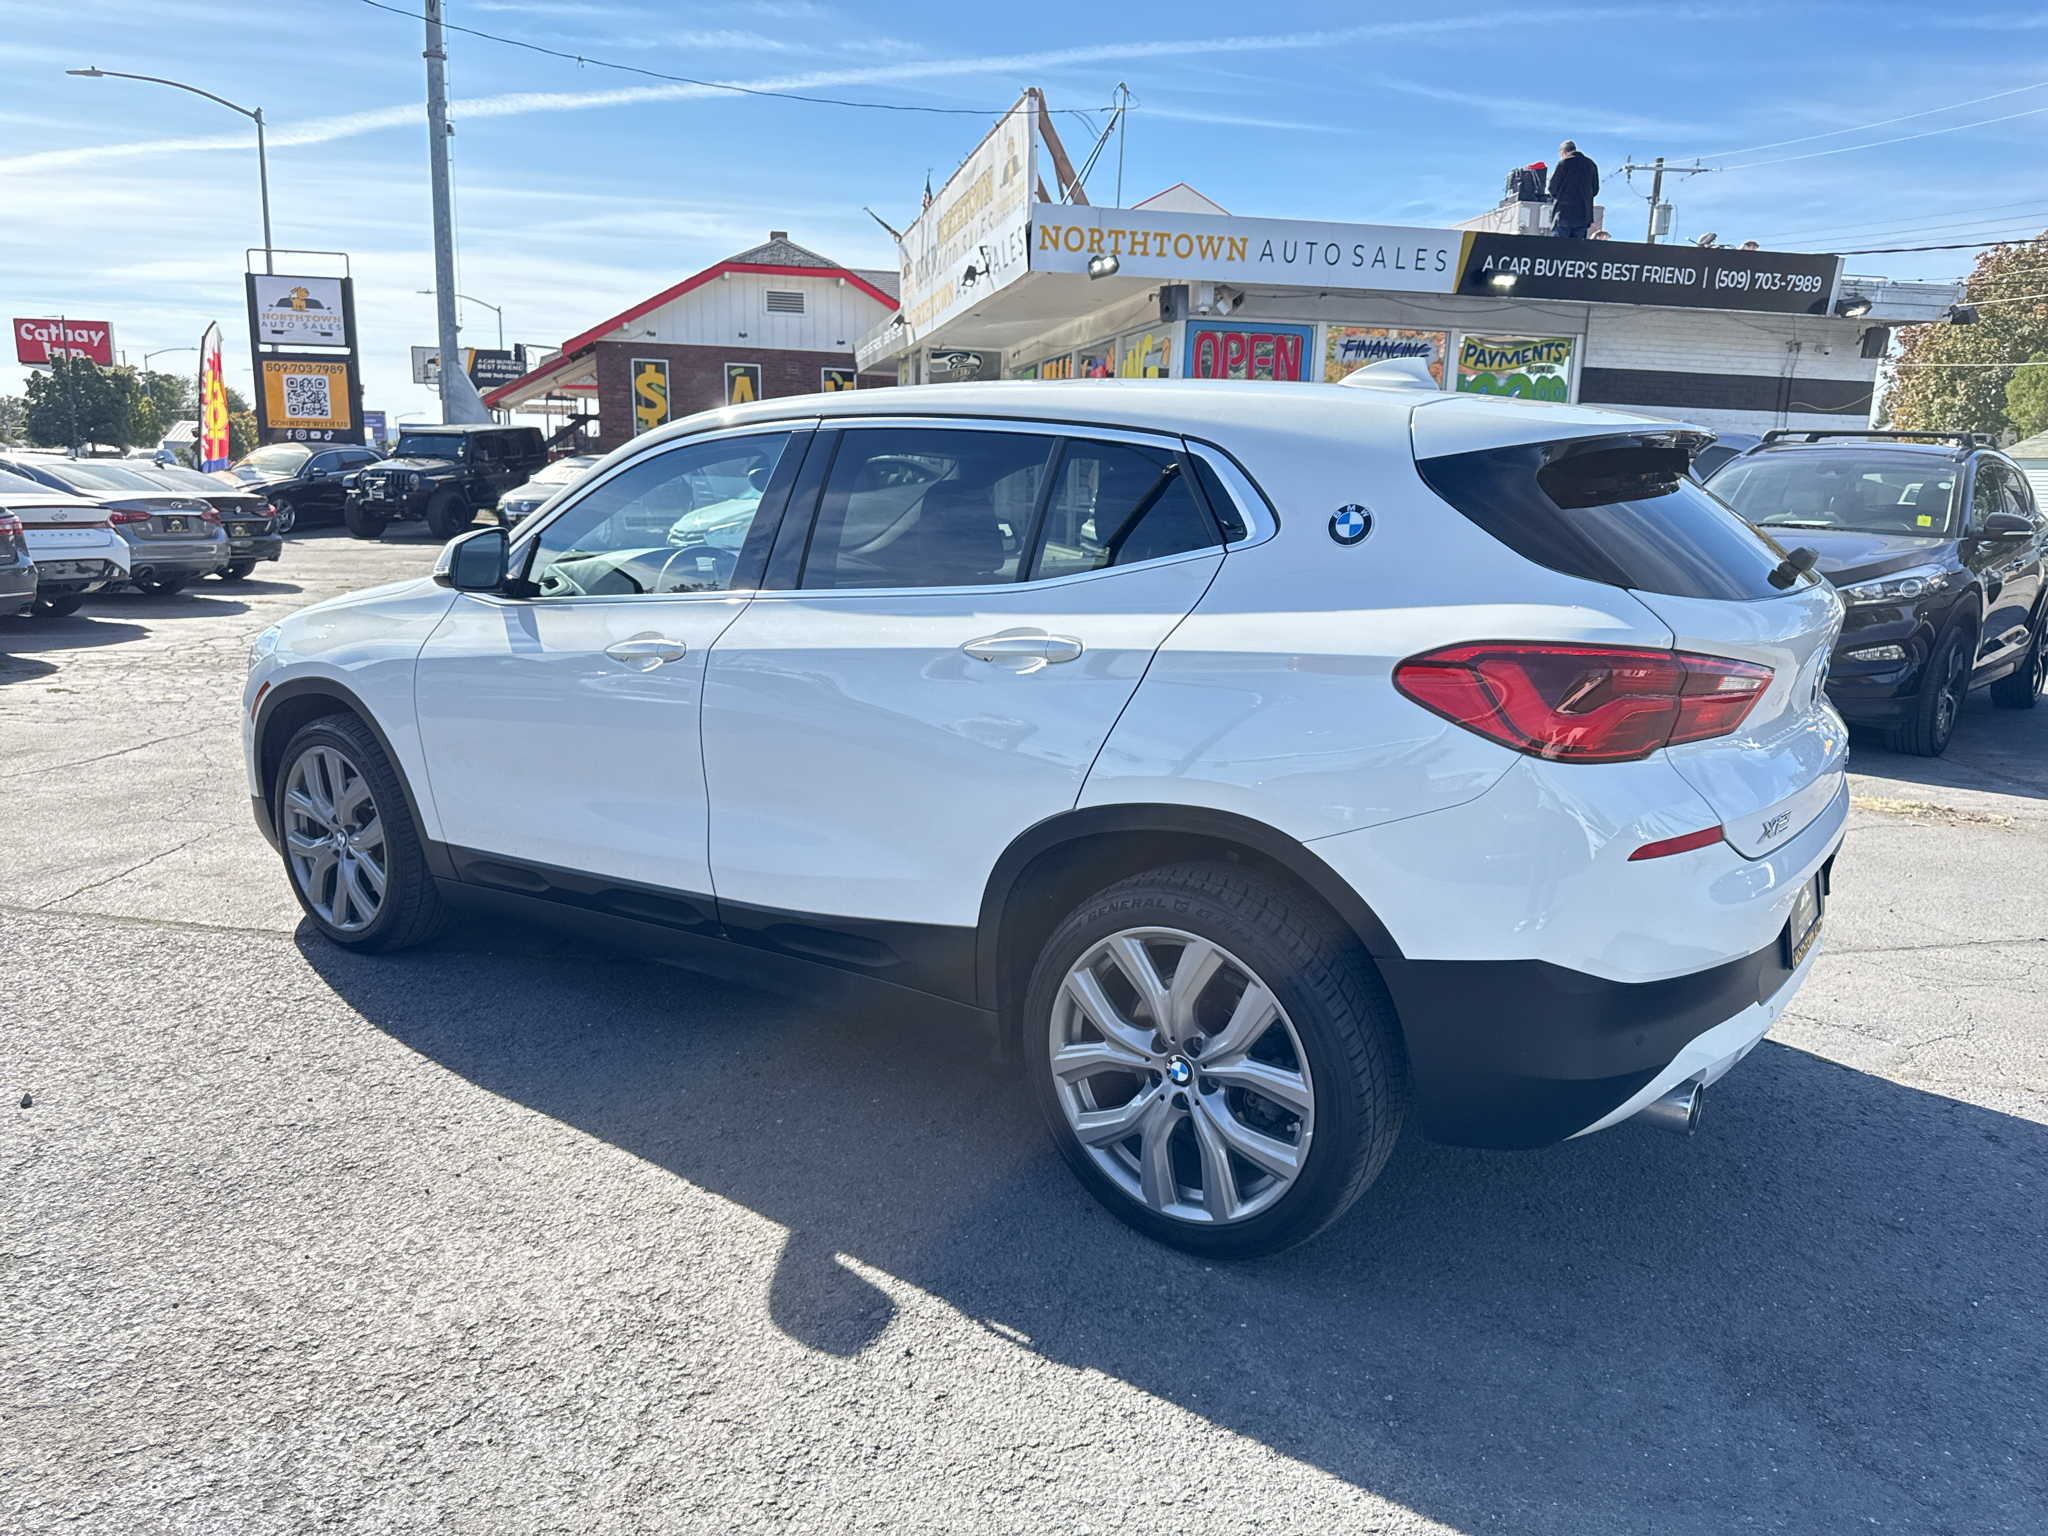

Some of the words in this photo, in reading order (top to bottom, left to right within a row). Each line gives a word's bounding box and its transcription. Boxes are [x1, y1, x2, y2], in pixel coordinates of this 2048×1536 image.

[1038, 224, 1249, 262] NORTHTOWN
[1258, 239, 1341, 266] AUTO
[1351, 244, 1448, 272] SALES
[1481, 254, 1494, 273] A
[1498, 255, 1532, 276] CAR
[1533, 258, 1599, 280] BUYER'S
[1600, 262, 1641, 282] BEST
[1641, 265, 1697, 286] FRIEND
[1714, 267, 1751, 291] (509)
[1753, 272, 1823, 293] 703-7989
[261, 313, 342, 323] NORTHTOWN
[261, 321, 296, 329] AUTO
[302, 322, 343, 331] SALES
[20, 322, 105, 347] Cathay
[1193, 330, 1302, 381] OPEN
[1463, 341, 1566, 369] PAYMENTS
[270, 419, 312, 427] CONNECT
[312, 420, 336, 428] WITH
[1087, 897, 1168, 923] GENERAL
